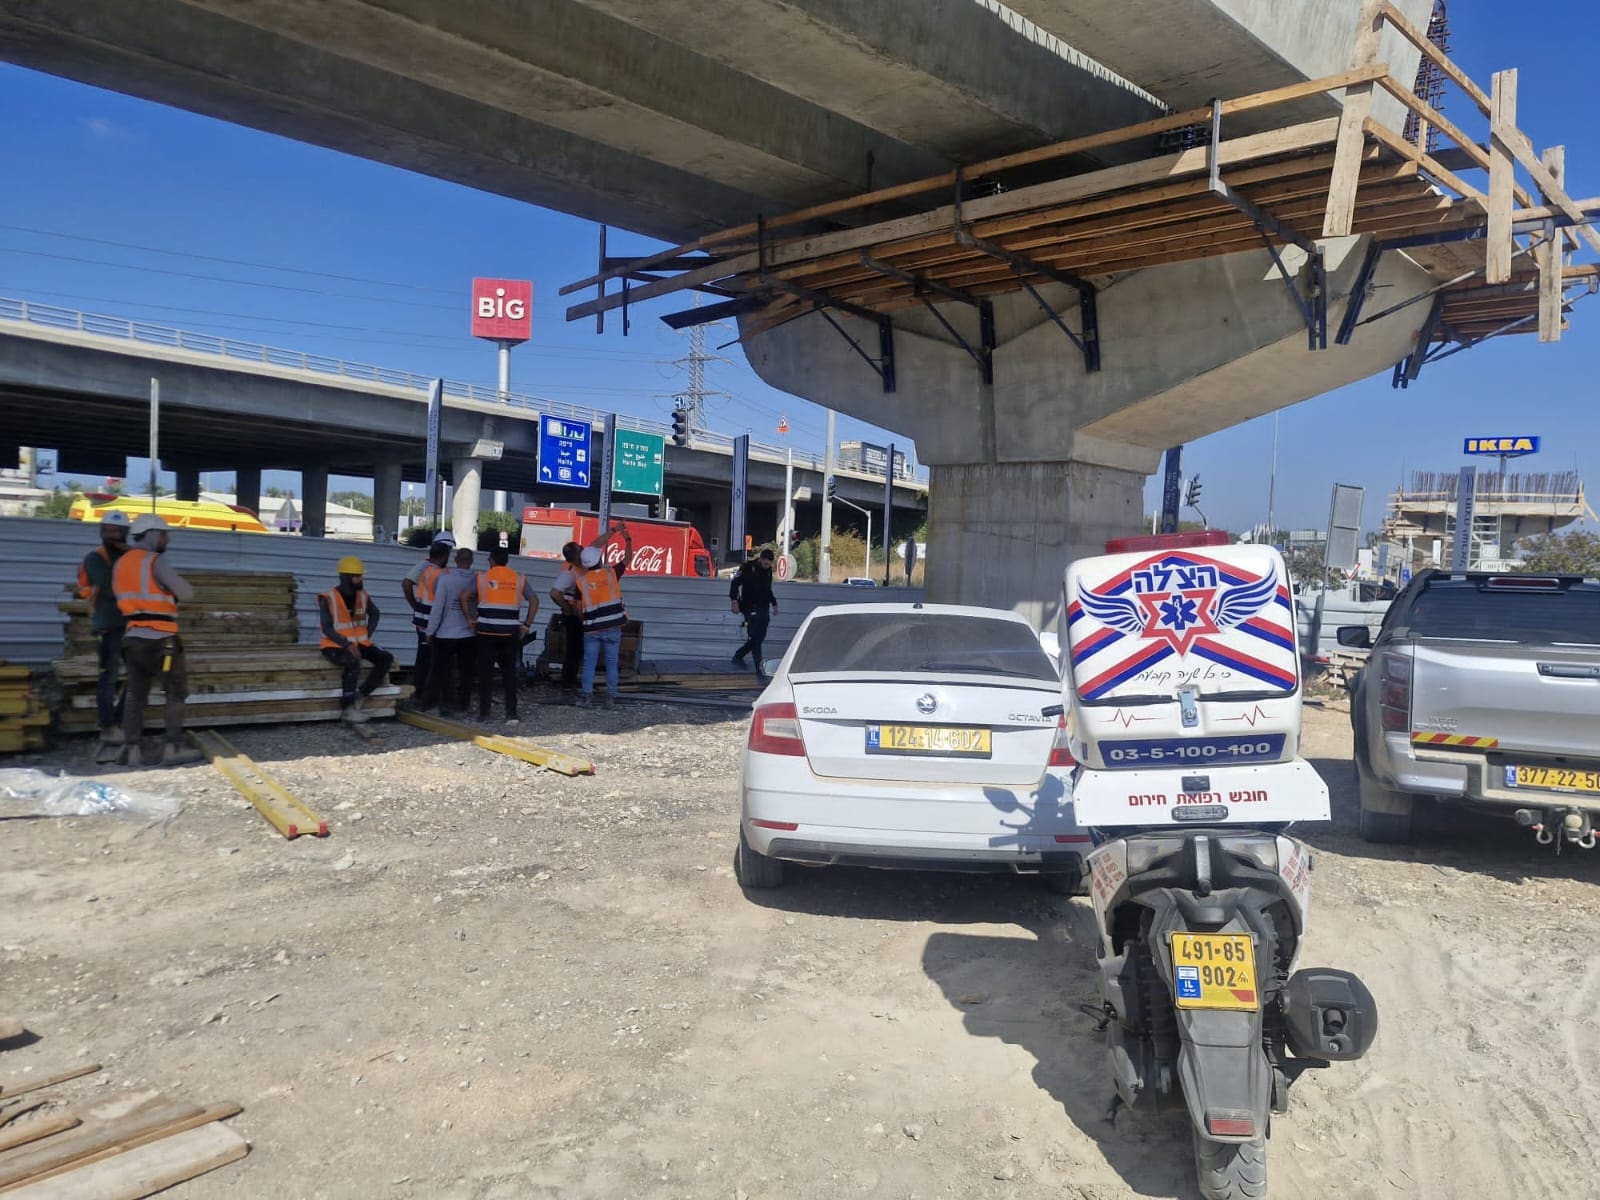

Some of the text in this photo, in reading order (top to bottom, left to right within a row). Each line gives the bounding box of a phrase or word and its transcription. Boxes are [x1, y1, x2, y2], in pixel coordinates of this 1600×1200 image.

[1468, 438, 1534, 452] IKEA
[1134, 564, 1218, 593] הצלה
[1135, 663, 1232, 686] כי כל שניה קובעת
[1110, 742, 1271, 761] 03-5-100-100
[1128, 790, 1268, 807] חובש רפואת חירום
[1184, 980, 1194, 989] IL
[1202, 965, 1238, 988] 902
